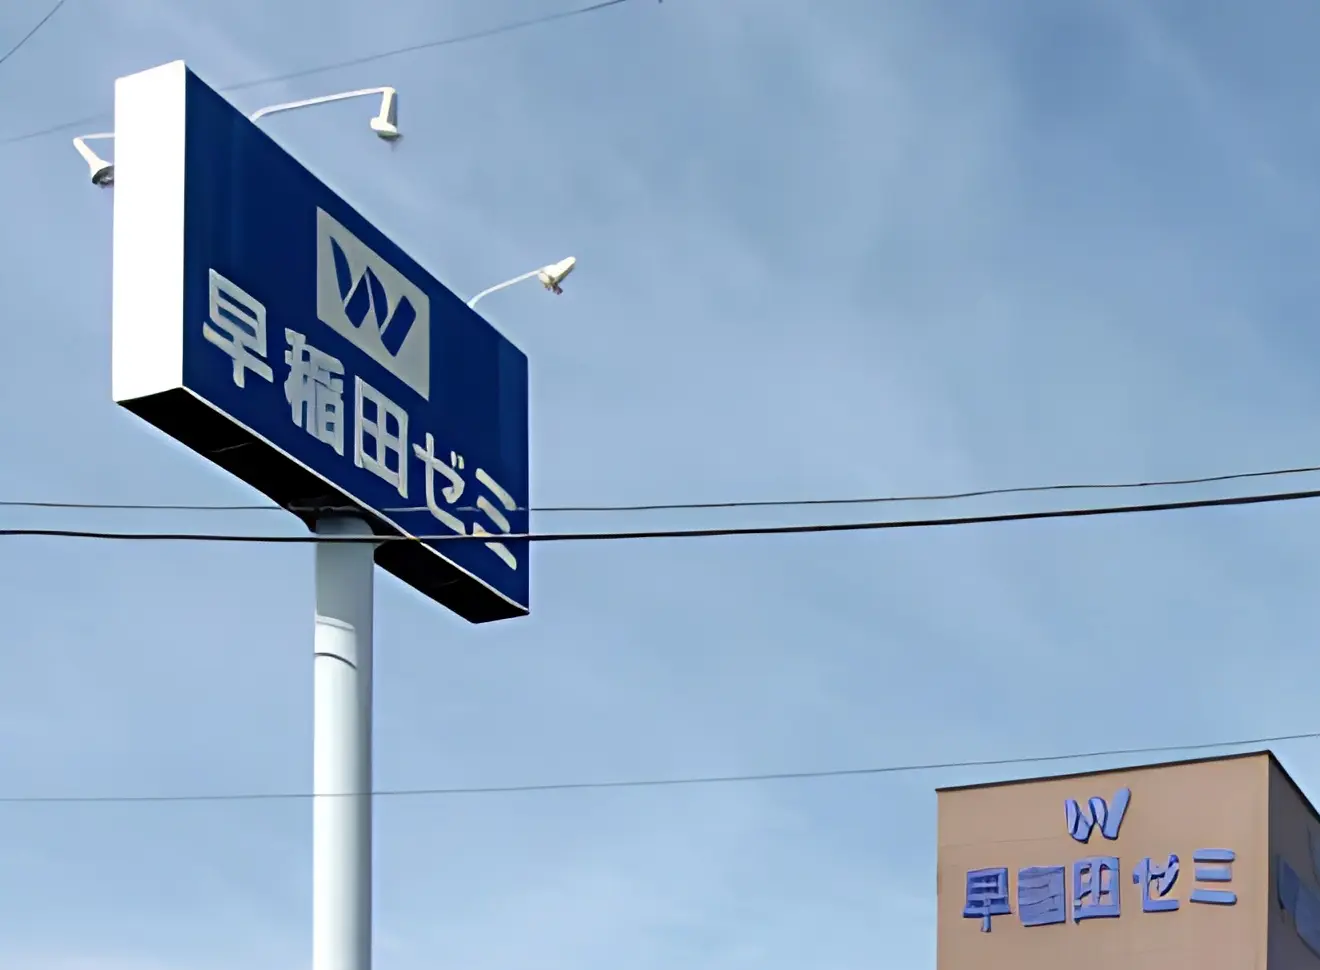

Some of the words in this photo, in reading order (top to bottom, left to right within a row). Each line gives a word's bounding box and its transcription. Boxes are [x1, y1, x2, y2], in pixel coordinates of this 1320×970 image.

[203, 268, 517, 570] 早稲田ゼミ
[962, 848, 1237, 932] 早田ゼミ
